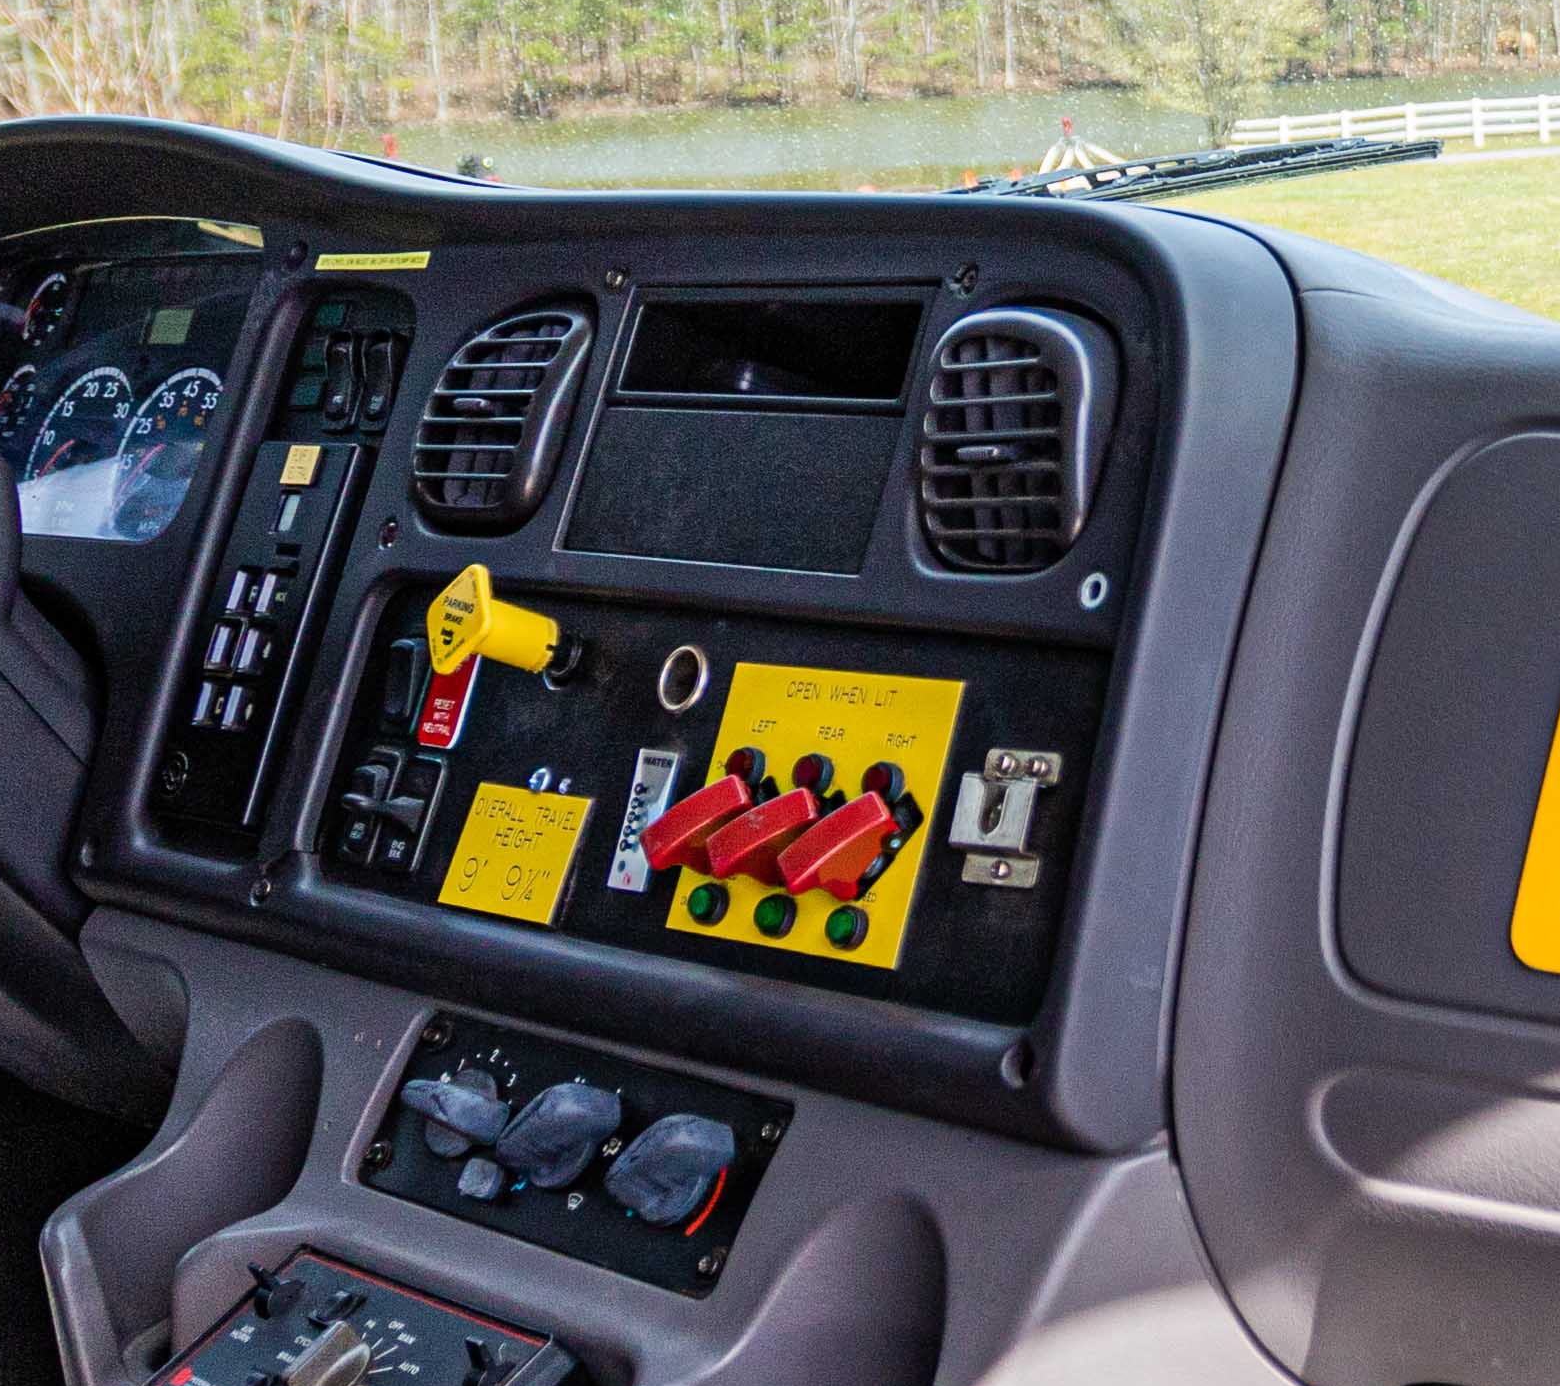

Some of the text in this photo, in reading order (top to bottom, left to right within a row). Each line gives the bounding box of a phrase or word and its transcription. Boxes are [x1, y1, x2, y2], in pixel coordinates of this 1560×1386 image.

[83, 382, 119, 398] 20 25
[183, 381, 200, 398] 45
[159, 392, 218, 409] 35 55
[62, 401, 130, 418] 15 30
[137, 418, 153, 434] 25
[43, 430, 56, 445] 10
[444, 596, 474, 613] PARKING
[443, 613, 463, 625] BRAKE
[787, 681, 898, 707] OPEN WHEN LIT
[434, 698, 455, 711] RESET
[423, 722, 450, 736] NEUTRAL
[752, 719, 917, 749] LEFT REAR RIGHT
[644, 756, 673, 769] WATER
[475, 797, 577, 831] OVERALL TRAVEL
[494, 827, 543, 850] HEIGHT
[399, 1362, 420, 1375] AUTO
